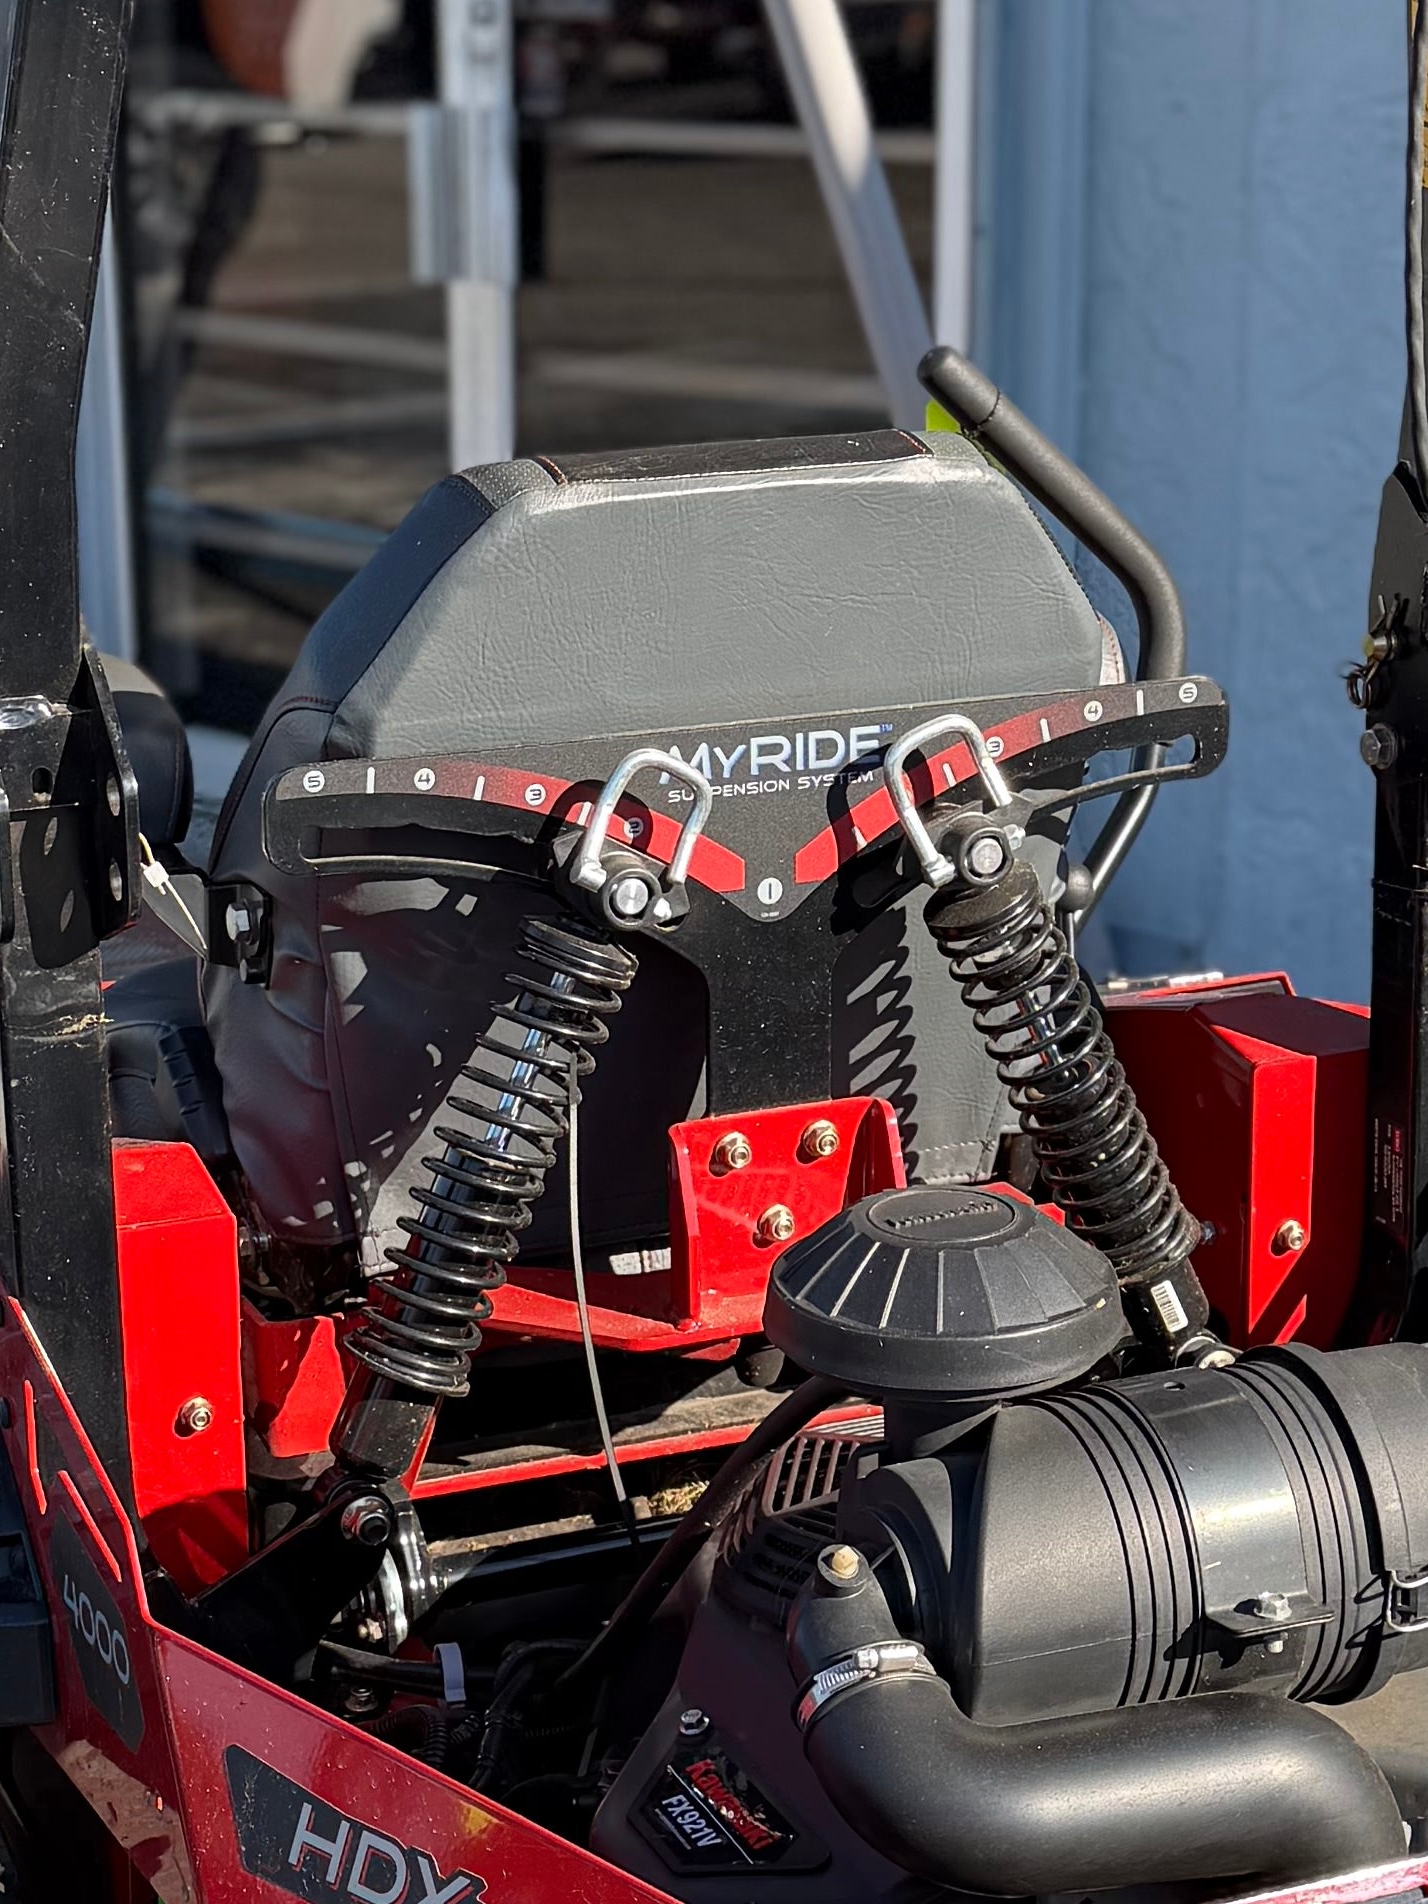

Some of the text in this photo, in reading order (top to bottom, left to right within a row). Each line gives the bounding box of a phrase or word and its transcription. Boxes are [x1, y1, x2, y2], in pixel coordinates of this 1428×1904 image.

[668, 778, 790, 804] SUPENSION
[63, 1573, 130, 1685] 4000
[661, 1794, 722, 1847] FX921V
